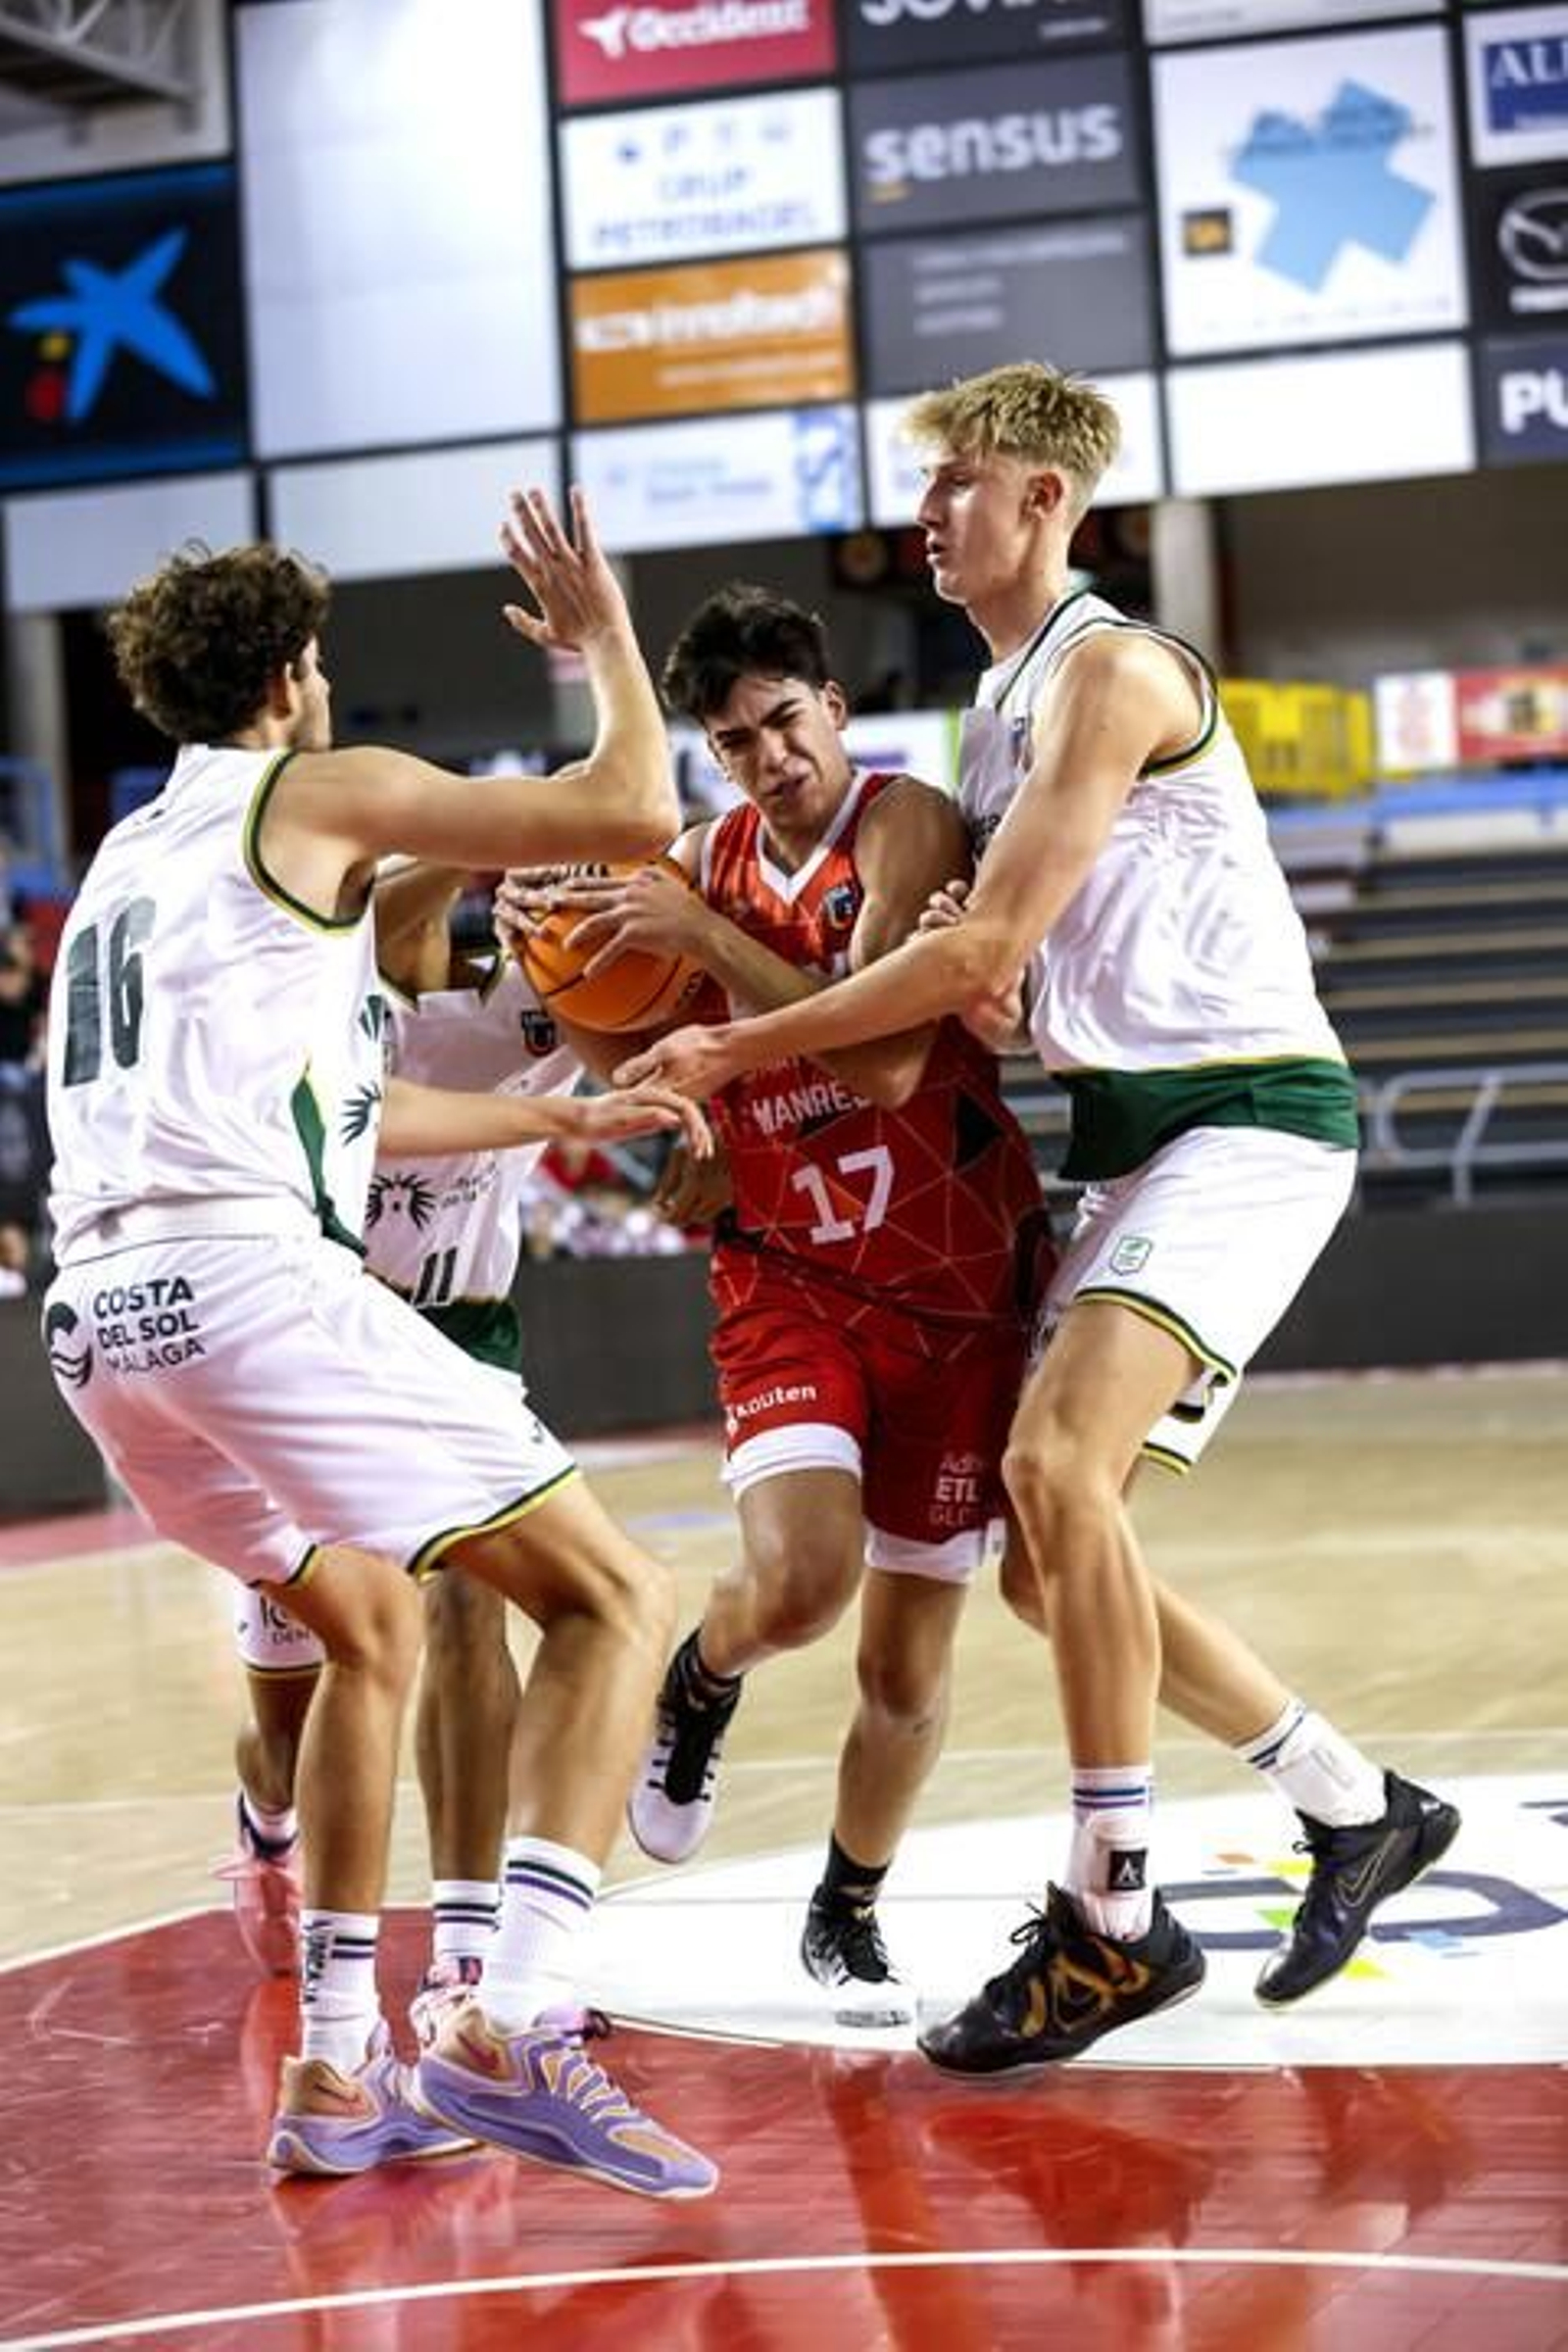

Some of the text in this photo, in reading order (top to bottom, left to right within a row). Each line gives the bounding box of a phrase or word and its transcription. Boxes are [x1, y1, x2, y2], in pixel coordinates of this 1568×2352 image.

[1491, 41, 1568, 87] AL
[864, 103, 1123, 182] sensus
[63, 897, 156, 1089] 16
[792, 1145, 896, 1246] 17
[93, 1276, 194, 1320] COSTA
[413, 1246, 458, 1305] 11
[97, 1309, 200, 1349] DEL SOL
[936, 1476, 979, 1503] ETL
